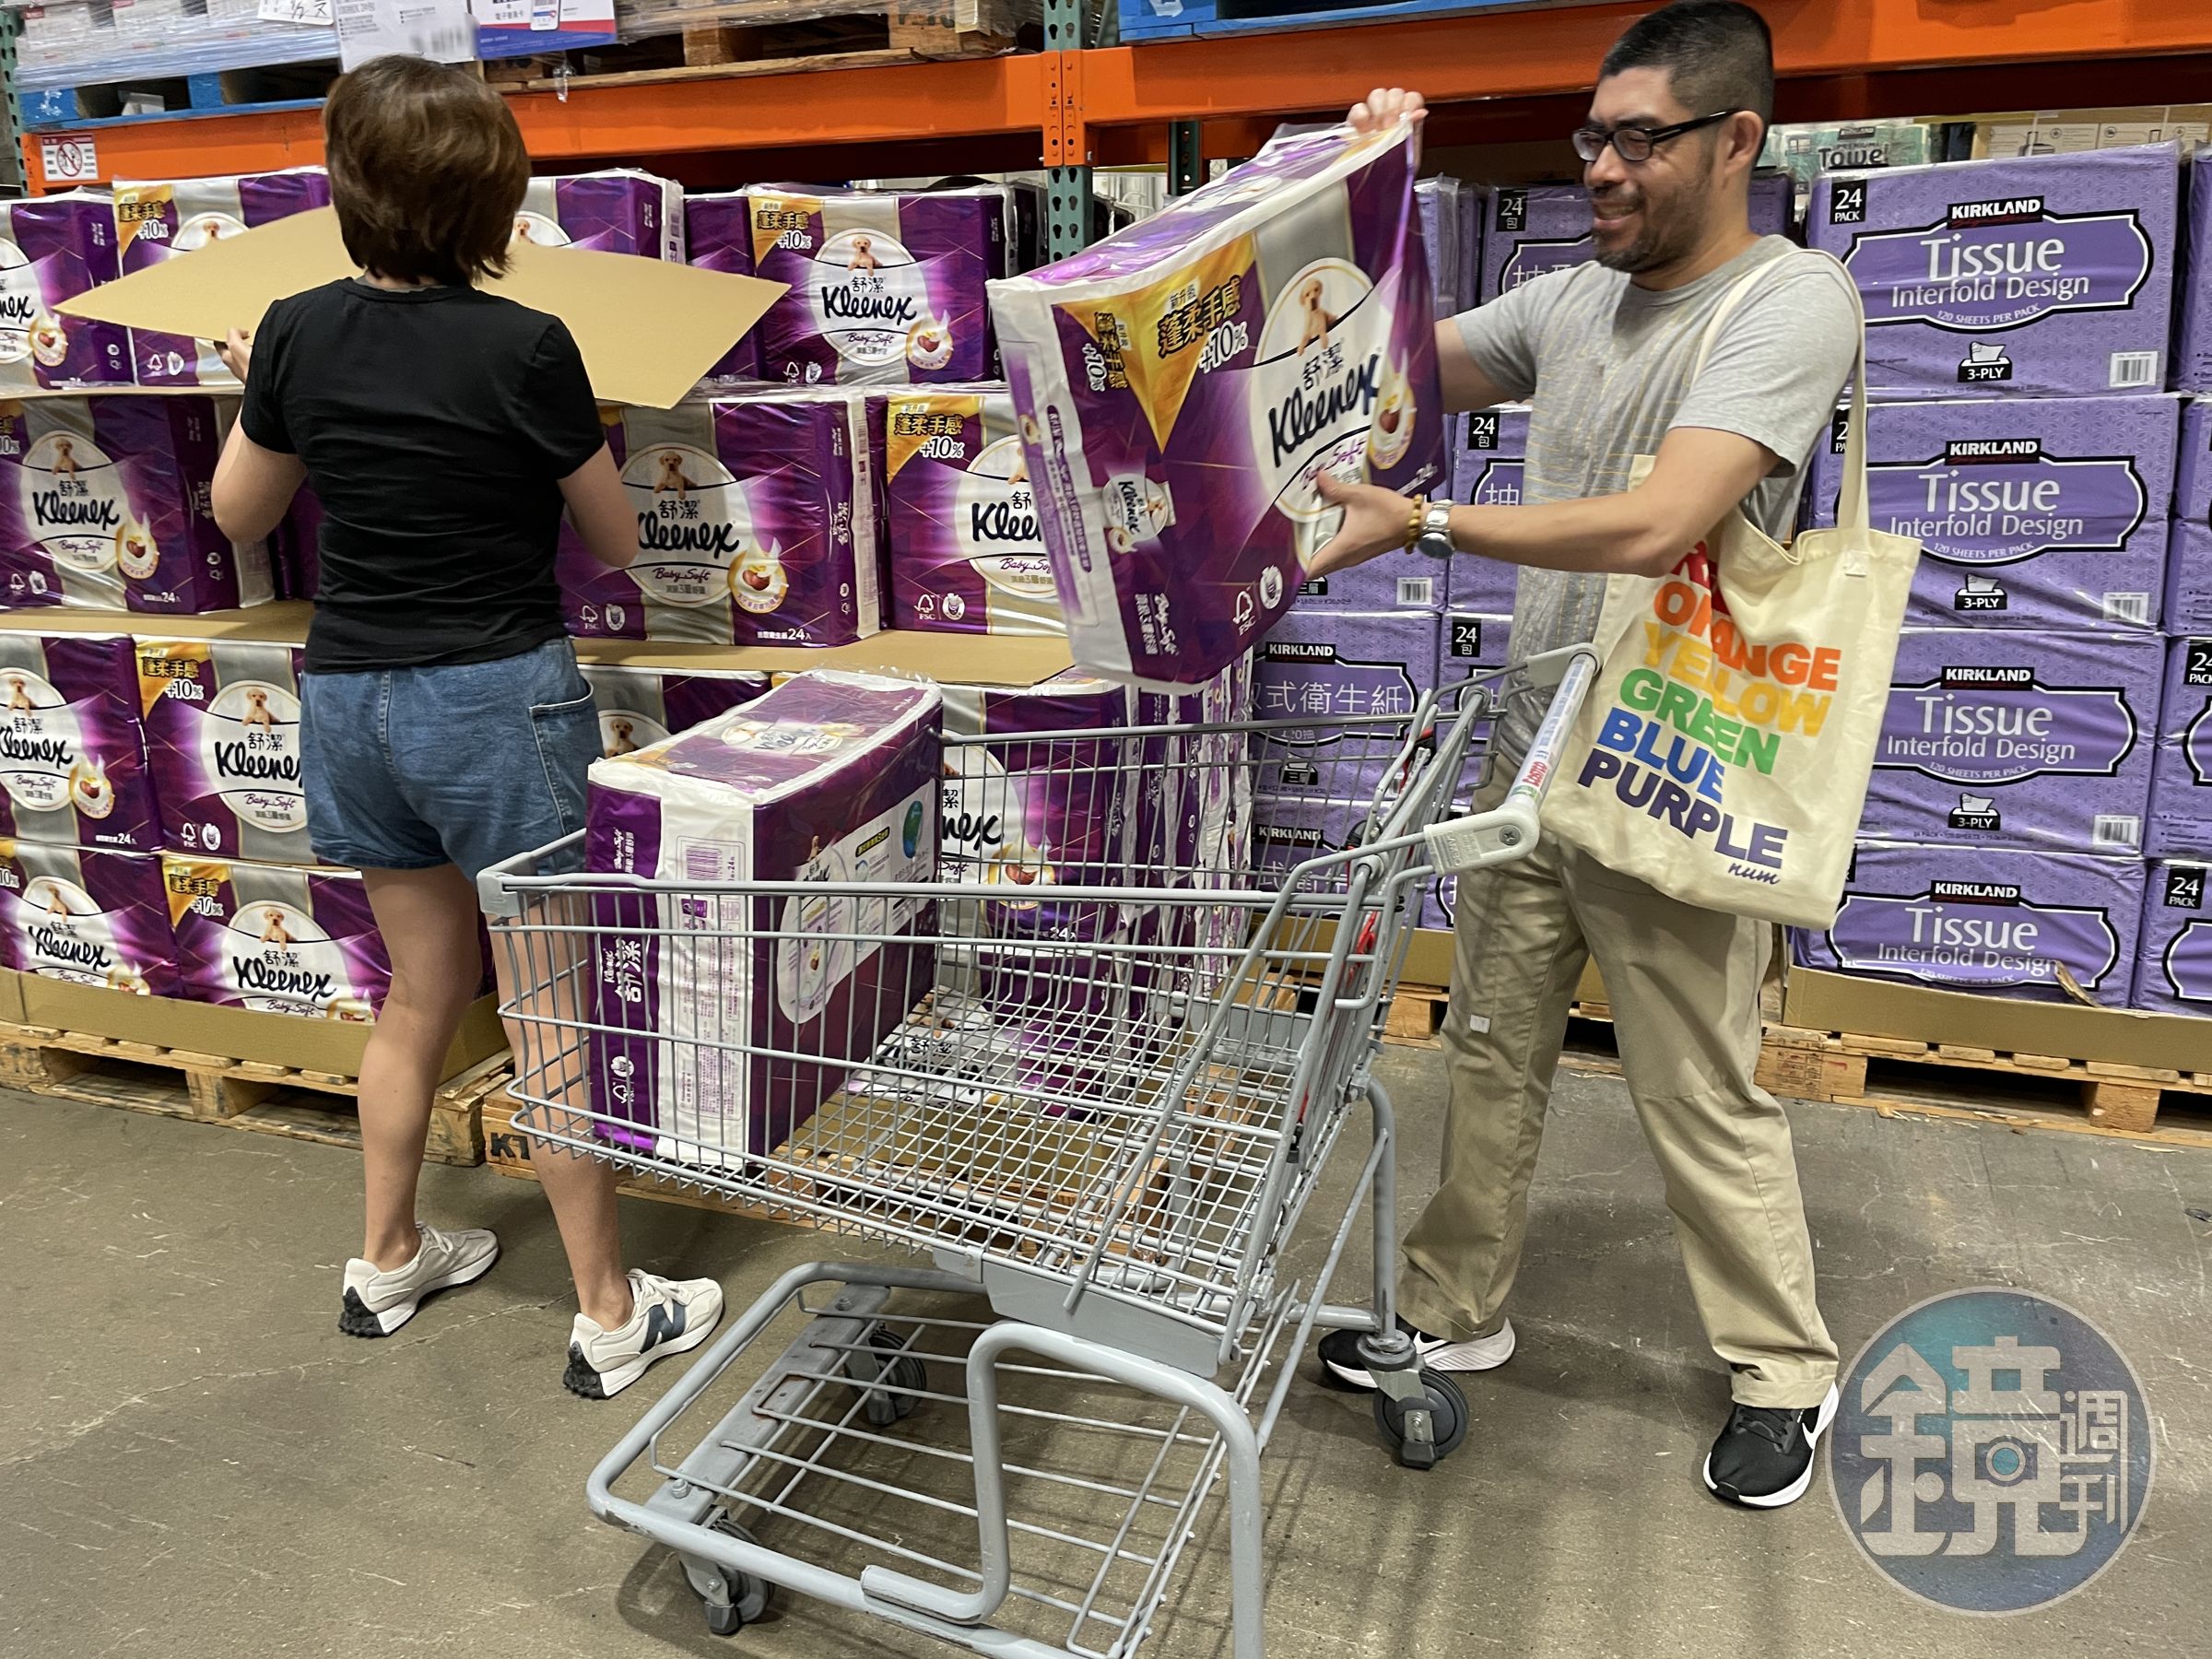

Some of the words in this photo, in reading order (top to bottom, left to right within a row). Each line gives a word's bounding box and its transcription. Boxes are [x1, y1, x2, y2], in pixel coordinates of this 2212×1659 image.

[1500, 198, 1523, 216] 24
[1835, 188, 1862, 210] 24
[1951, 199, 2041, 219] KIRKLAND
[1834, 211, 1860, 222] PACK
[1920, 233, 2065, 282] Tissue
[852, 277, 884, 293] 舒潔
[1892, 276, 1995, 308] Interfold
[2006, 272, 2089, 302] Design
[821, 286, 917, 325] Kleenex
[1936, 310, 1953, 322] 120
[1955, 312, 1990, 324] SHEETS
[1994, 312, 2013, 324] PER
[2014, 303, 2041, 320] PACK
[1158, 275, 1241, 359] 蓬柔手感
[1198, 321, 1248, 373] +10%
[1968, 367, 2005, 381] 3-PLY
[1268, 354, 1379, 468] Kleenex
[894, 414, 963, 436] 蓬柔手感
[1473, 417, 1495, 435] 24
[1837, 421, 1848, 441] 2
[920, 436, 964, 458] +10%
[1478, 436, 1490, 448] 包
[1949, 441, 2038, 456] KIRKLAND
[1011, 491, 1031, 511] 舒
[1919, 469, 2060, 513] Tissue
[32, 492, 120, 531] Kleenex
[658, 500, 699, 520] 舒潔
[971, 501, 1042, 542] Klee
[1890, 514, 1991, 539] Interfold
[2001, 512, 2085, 540] Design
[1934, 542, 1950, 553] 120
[1952, 547, 1986, 559] SHEETS
[1989, 546, 2006, 558] PER
[2008, 541, 2034, 555] PACK
[653, 569, 681, 582] Baby
[685, 568, 711, 582] Soft
[1000, 558, 1029, 572] Baby
[1033, 559, 1052, 572] So
[1963, 597, 1999, 608] 3-PLY
[1455, 626, 1477, 643] 24
[1269, 644, 1334, 657] KIRKLAND
[1644, 620, 1832, 737] YELOW
[1946, 668, 2031, 682] KIRKLAND
[166, 679, 204, 700] +10%
[1915, 693, 2053, 735] Tissue
[14, 717, 43, 735] 舒潔
[248, 732, 283, 751] 舒潔
[1887, 735, 1986, 758] Interfold
[1996, 737, 2076, 764] Design
[1596, 707, 1724, 804] BLUE
[1929, 761, 1945, 772] 120
[1946, 766, 1981, 778] SHEETS
[1983, 767, 2001, 778] PER
[2003, 764, 2028, 776] PACK
[244, 793, 269, 807] Baby
[274, 794, 297, 809] Soft
[1576, 747, 1788, 868] PURPLE
[1958, 818, 1993, 828] 3-PLY
[1935, 883, 2018, 898] KIRKLAND
[2171, 877, 2199, 896] 24
[2169, 897, 2195, 907] PACK
[1904, 905, 2039, 951] Tissue
[29, 926, 112, 969] Kleenex
[264, 949, 299, 968] 舒潔
[1878, 943, 1973, 967] Interfold
[1983, 952, 2058, 977] Design
[233, 957, 336, 997] Kleenex
